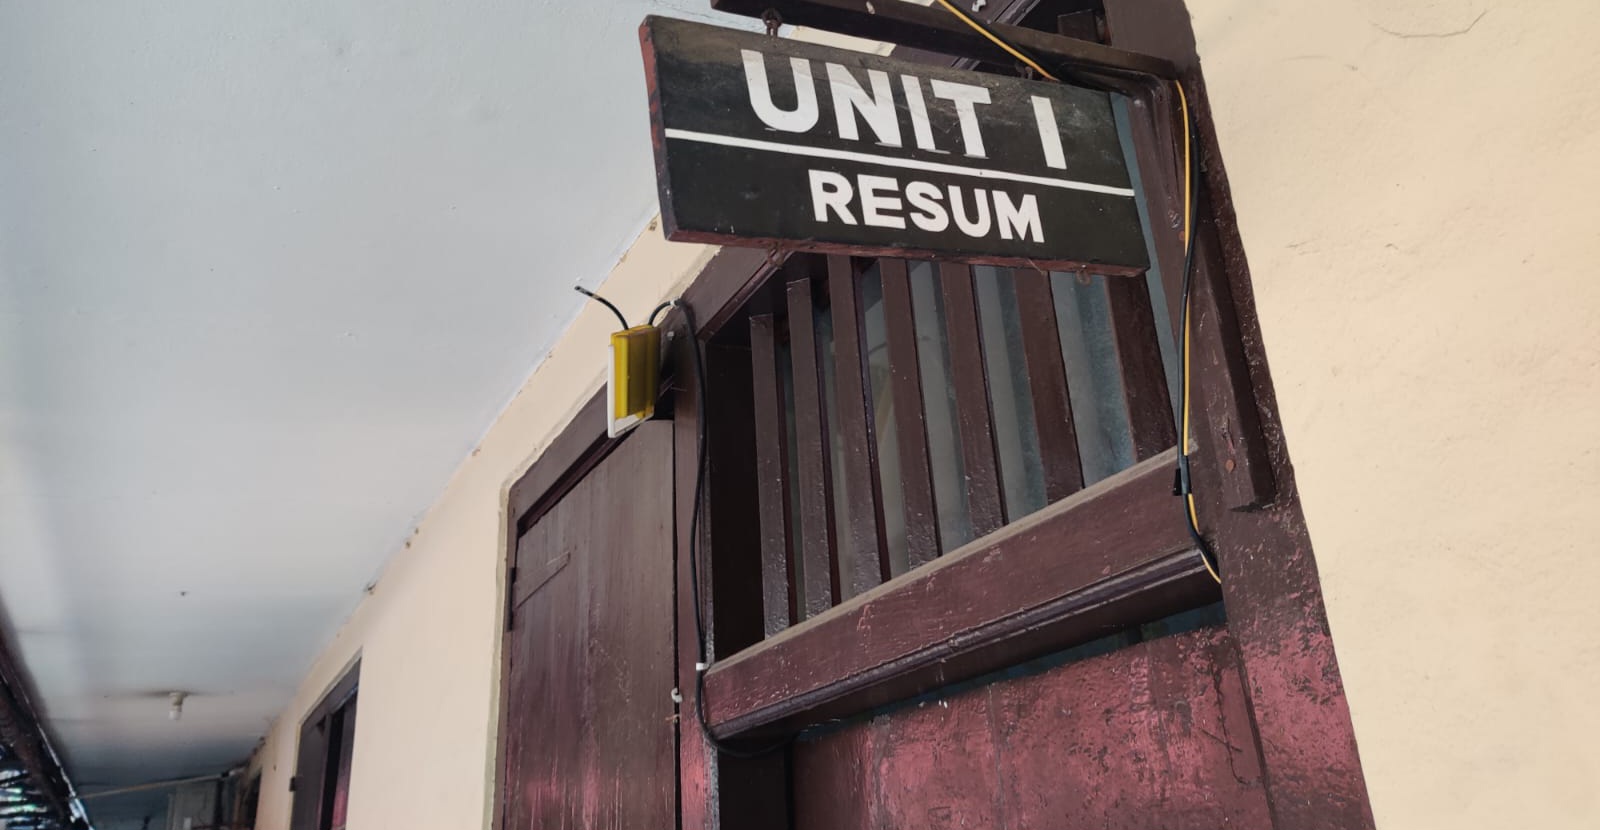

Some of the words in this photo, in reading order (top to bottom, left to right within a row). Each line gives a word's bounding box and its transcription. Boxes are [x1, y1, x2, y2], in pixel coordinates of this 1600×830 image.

[740, 49, 992, 159] UNIT
[1030, 95, 1067, 170] I
[808, 169, 1045, 244] RESUM
